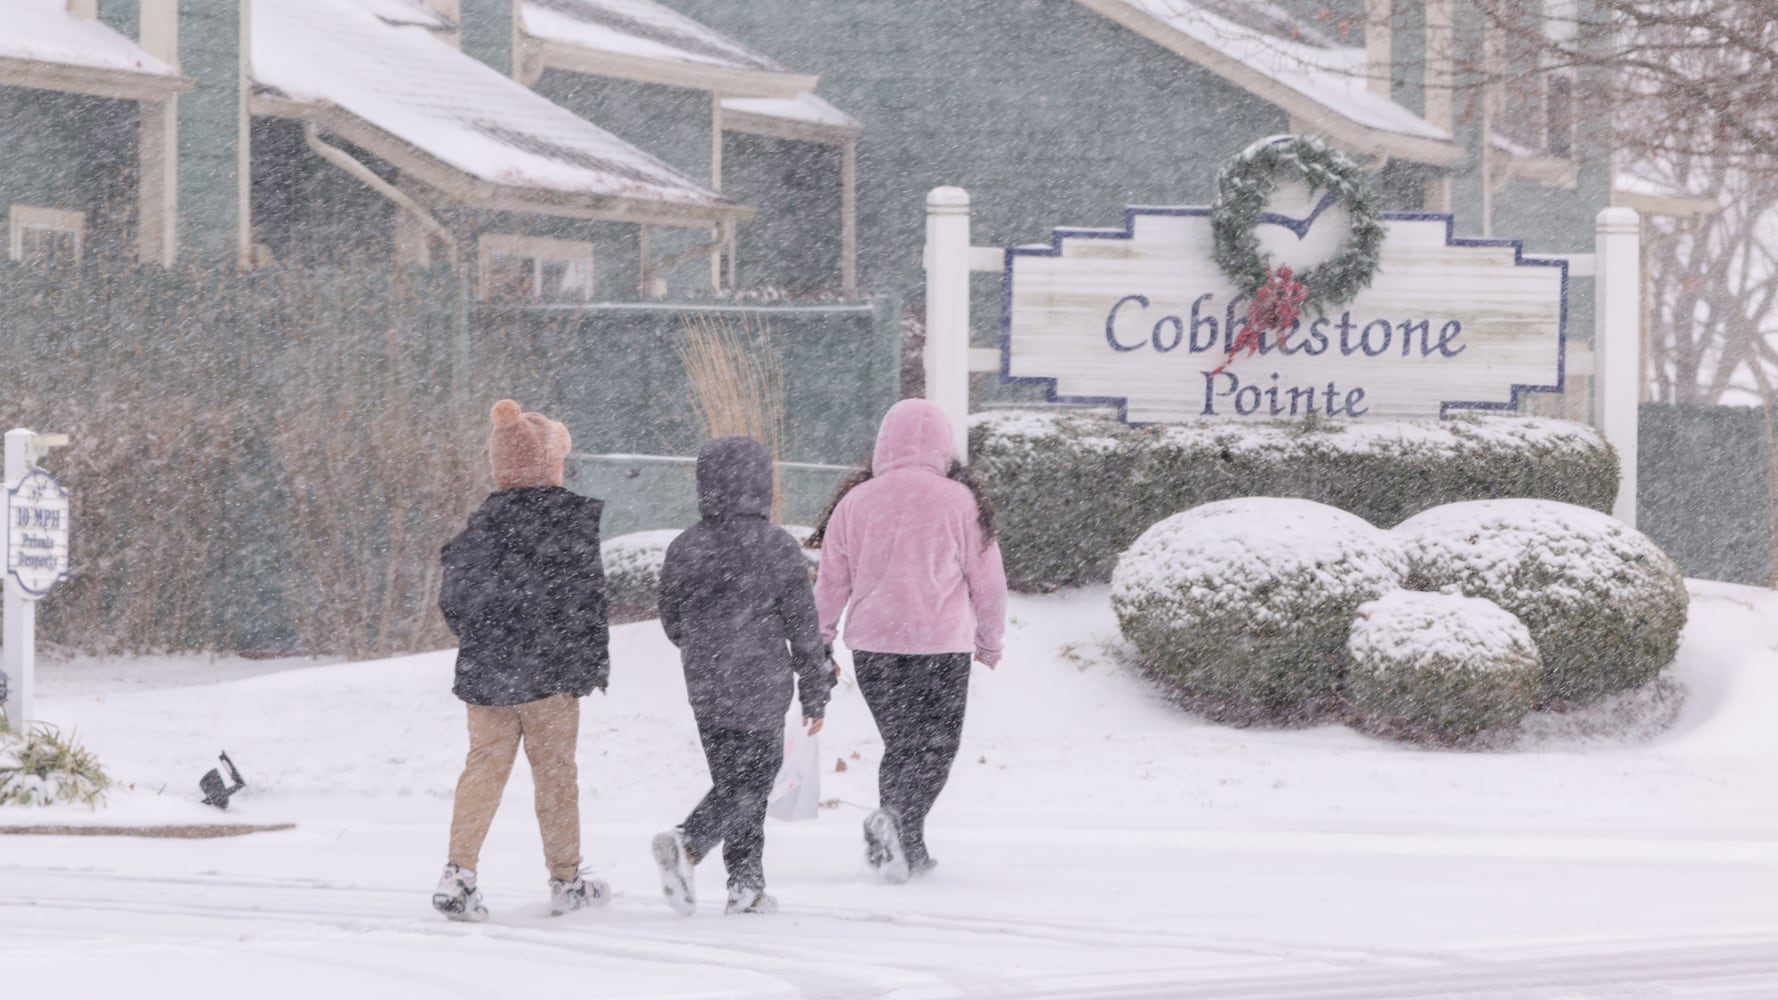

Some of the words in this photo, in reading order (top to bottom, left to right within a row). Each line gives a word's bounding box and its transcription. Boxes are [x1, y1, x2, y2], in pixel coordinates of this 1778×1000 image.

[1200, 370, 1369, 417] Pointe
[17, 506, 30, 527] 10
[33, 508, 60, 528] MPH
[21, 532, 54, 549] Private
[18, 551, 57, 571] Property
